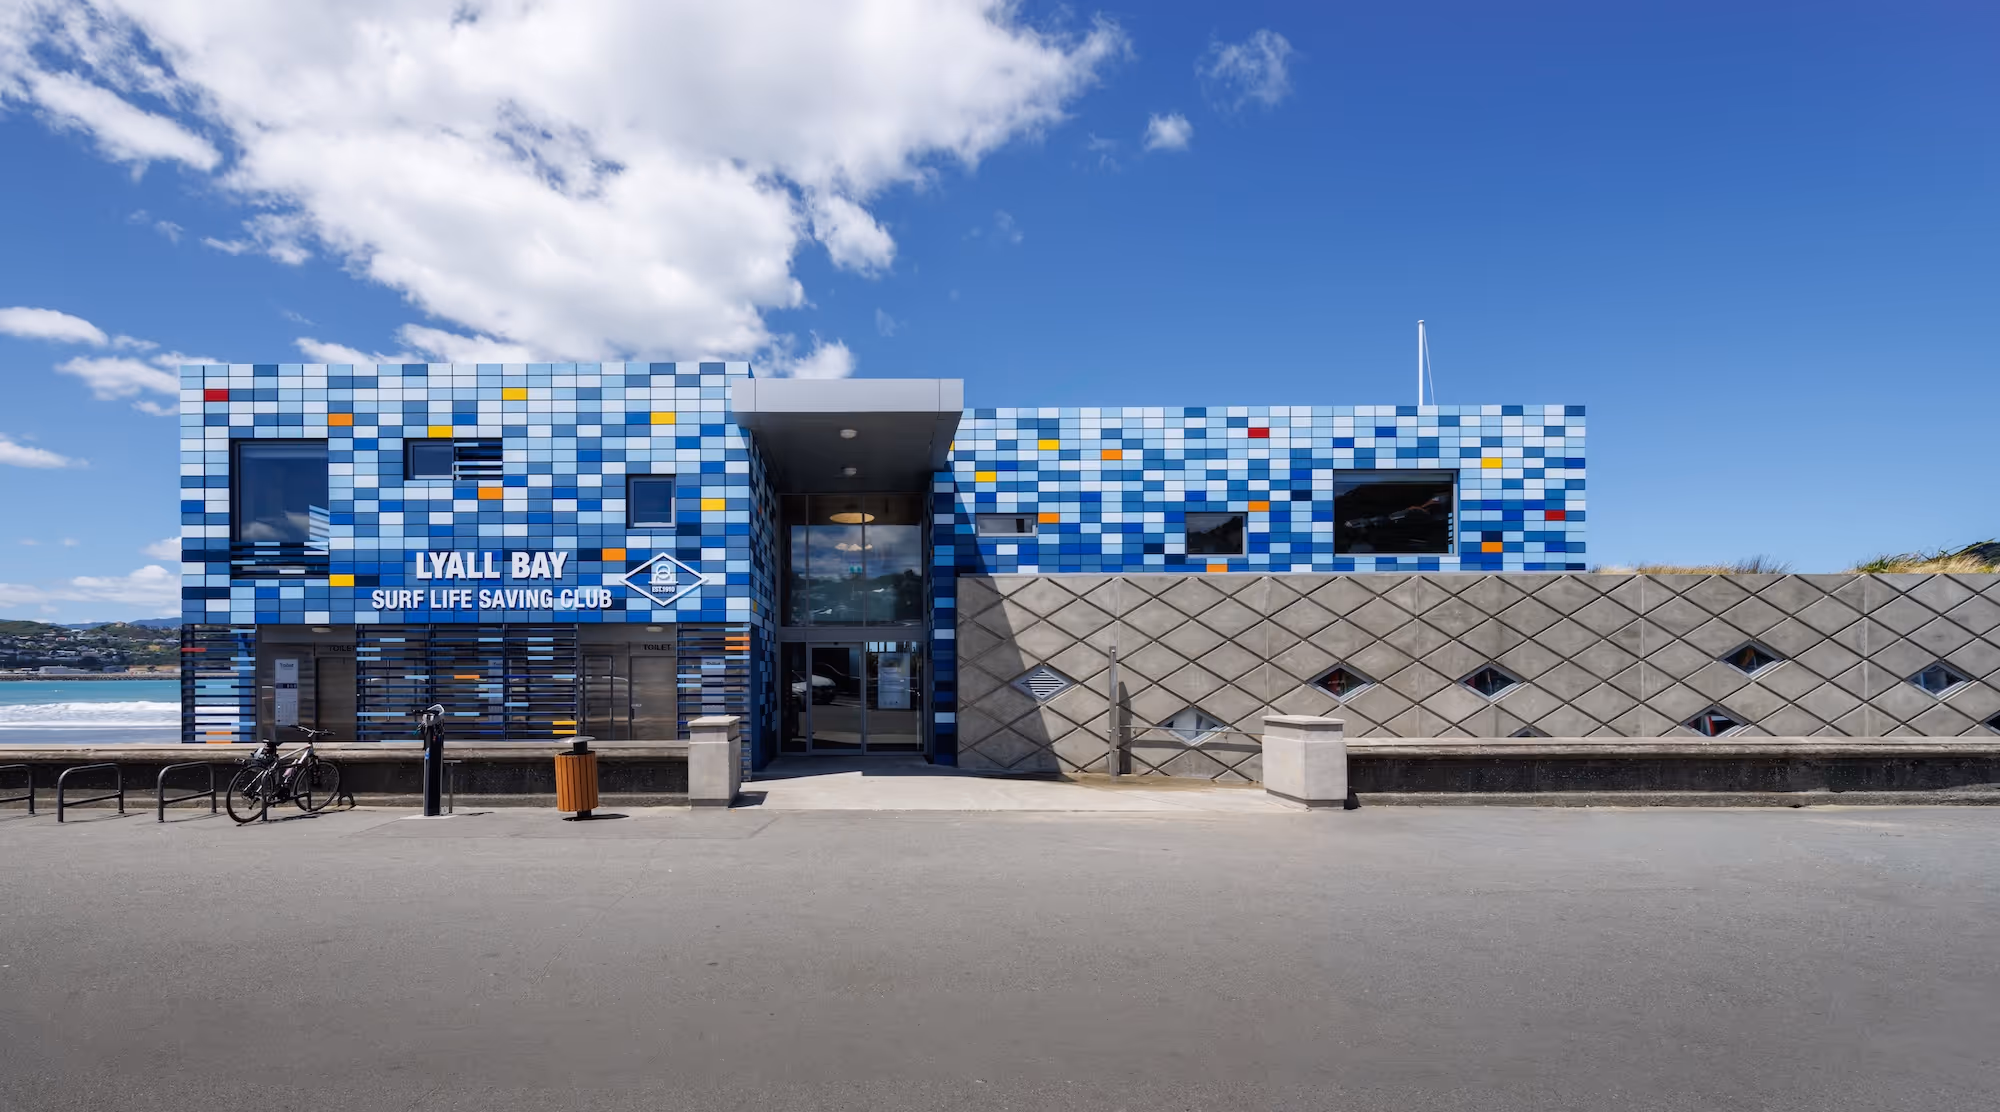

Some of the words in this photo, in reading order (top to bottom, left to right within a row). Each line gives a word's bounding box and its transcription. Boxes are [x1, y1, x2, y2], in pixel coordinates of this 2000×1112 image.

[415, 551, 500, 579] LYALL
[511, 551, 568, 579] BAY
[371, 589, 424, 609] SURF
[430, 589, 472, 609] LIFE
[478, 589, 553, 609] SAVING
[560, 589, 612, 609] CLUB
